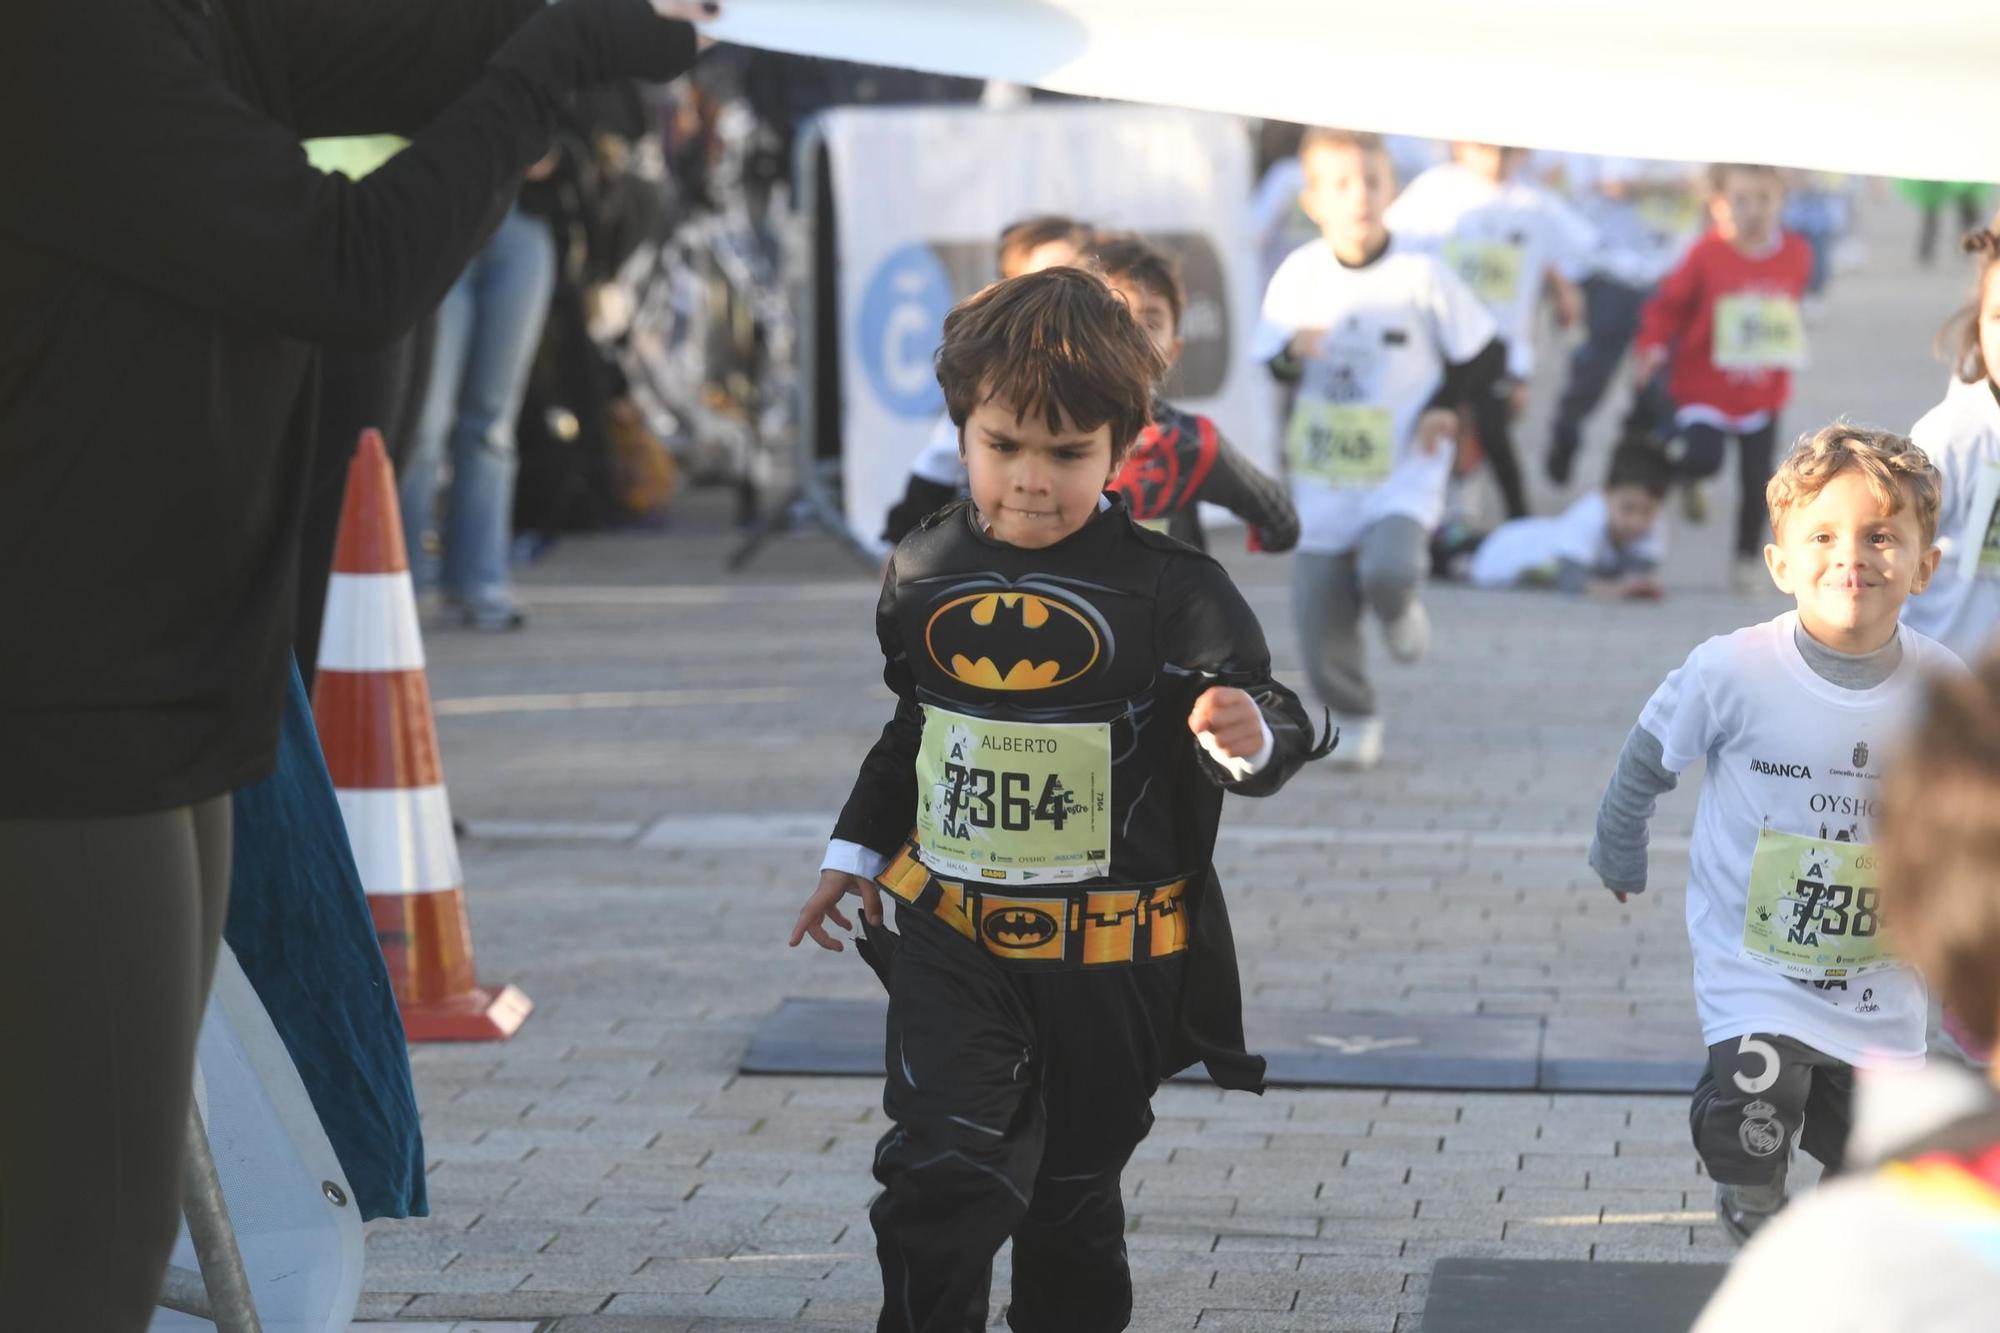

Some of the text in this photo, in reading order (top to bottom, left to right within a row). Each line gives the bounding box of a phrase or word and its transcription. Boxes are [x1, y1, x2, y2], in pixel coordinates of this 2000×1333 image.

[980, 734, 1058, 755] ALBERTO
[944, 761, 1068, 832] 7364
[1796, 878, 1884, 937] 738
[1733, 1033, 1781, 1094] 5
